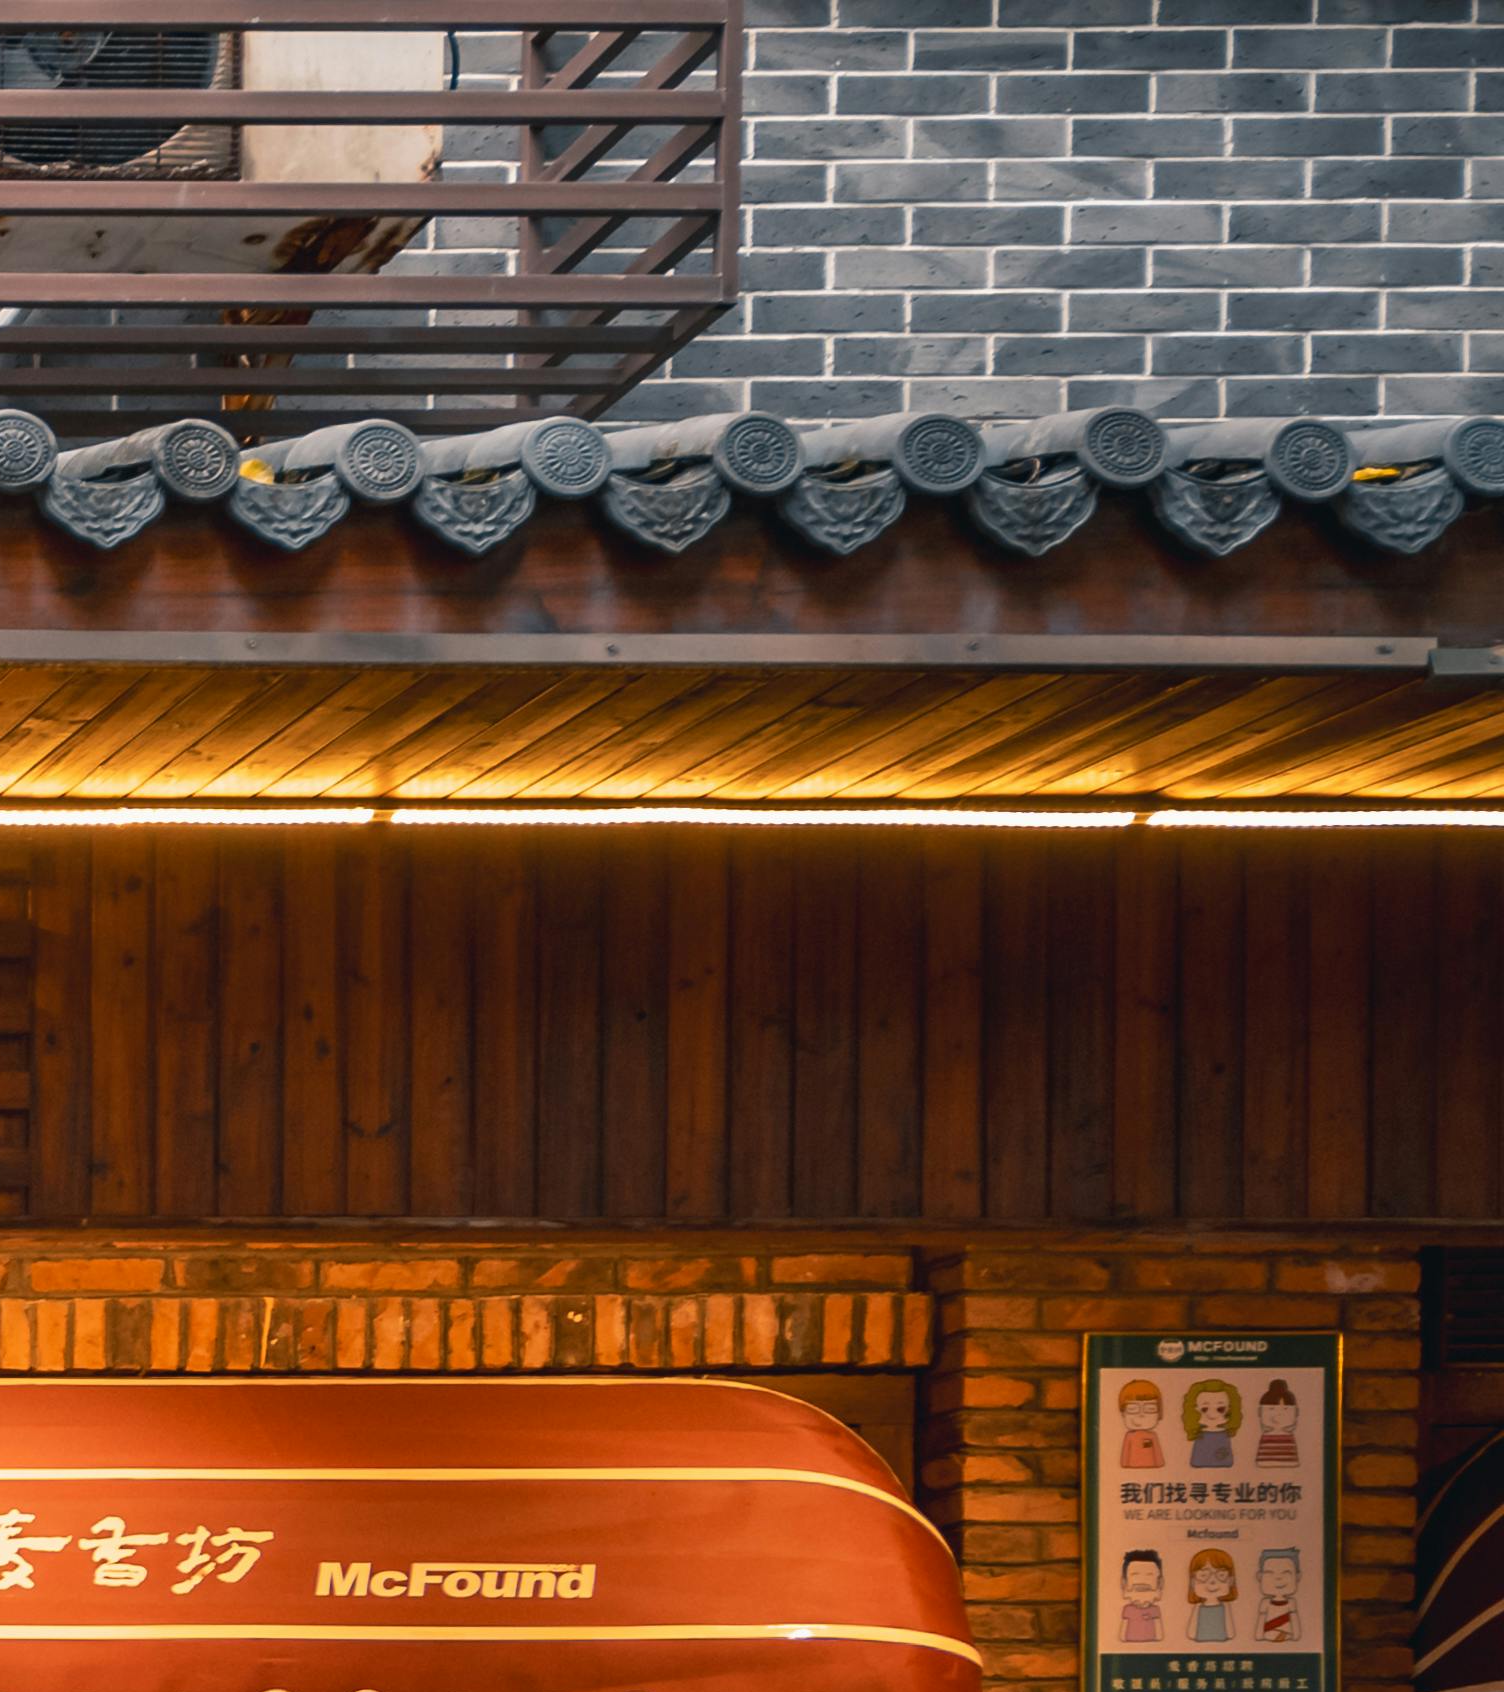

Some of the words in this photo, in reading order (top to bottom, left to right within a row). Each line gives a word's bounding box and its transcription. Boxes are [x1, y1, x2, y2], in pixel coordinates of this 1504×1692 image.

[1188, 1340, 1268, 1353] MCFOUND
[1120, 1482, 1303, 1505] 我们找寻专业的你
[1124, 1508, 1143, 1521] WE
[1148, 1508, 1171, 1521] ARE
[1176, 1508, 1236, 1521] LOOKING
[1240, 1508, 1265, 1521] FOR
[1269, 1508, 1297, 1521] YOU
[315, 1561, 596, 1599] McFound
